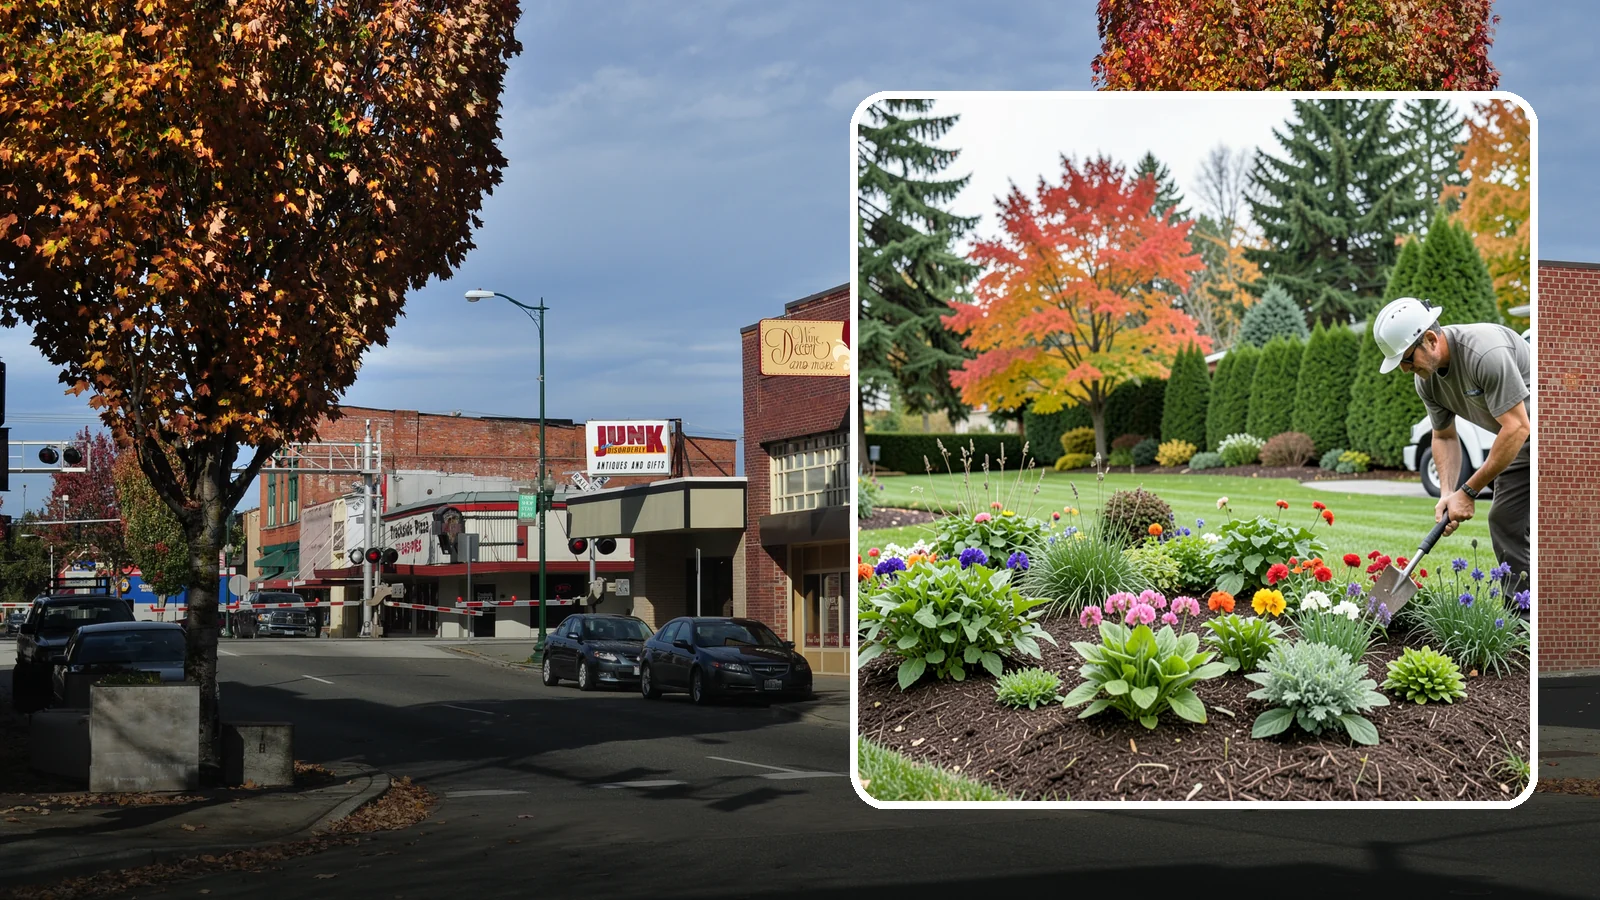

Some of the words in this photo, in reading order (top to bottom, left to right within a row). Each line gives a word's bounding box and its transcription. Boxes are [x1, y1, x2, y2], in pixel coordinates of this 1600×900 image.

[596, 425, 665, 457] JUNK
[607, 446, 646, 454] DISORDERLY
[597, 461, 628, 470] ANTIQUES
[631, 461, 644, 470] AND
[647, 460, 665, 469] GIFTS
[390, 521, 413, 539] Trackside
[414, 519, 429, 535] Pizza
